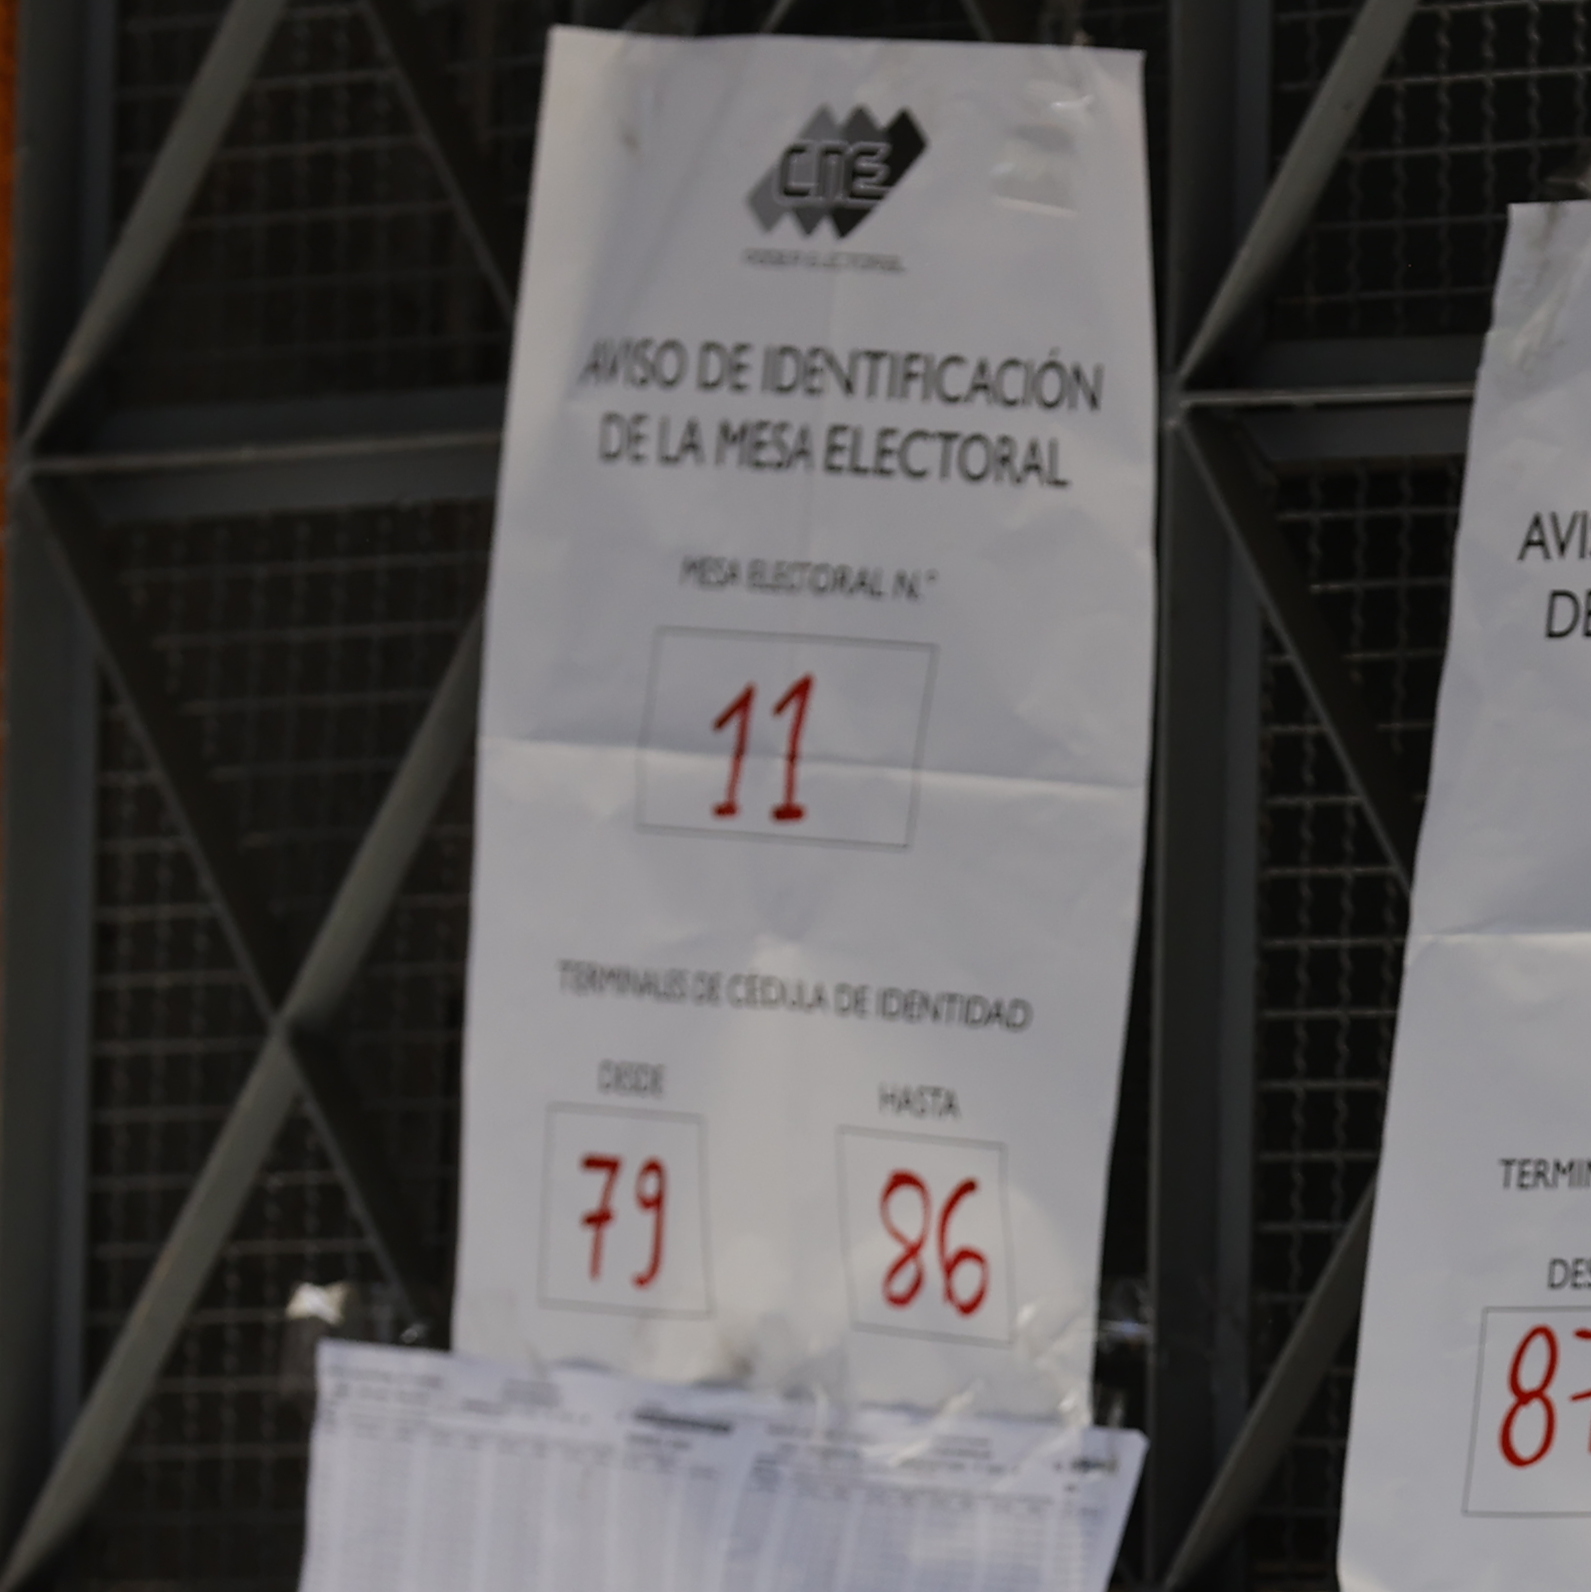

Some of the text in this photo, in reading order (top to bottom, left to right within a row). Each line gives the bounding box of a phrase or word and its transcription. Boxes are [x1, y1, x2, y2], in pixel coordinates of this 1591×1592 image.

[578, 337, 1102, 412] AVISO DE IDENTIFICACIÓN
[600, 412, 1071, 488] DE LA MESA ELECTORAL
[681, 555, 741, 589] MESA
[746, 559, 885, 597] ELECTORAL
[712, 672, 815, 821] 11
[694, 970, 724, 1006] DE
[833, 981, 872, 1018] DE
[874, 986, 1034, 1033] IDENTIDAD
[598, 1058, 960, 1120] DESDE HASTA
[581, 1154, 669, 1288] 79
[879, 1169, 990, 1316] 86
